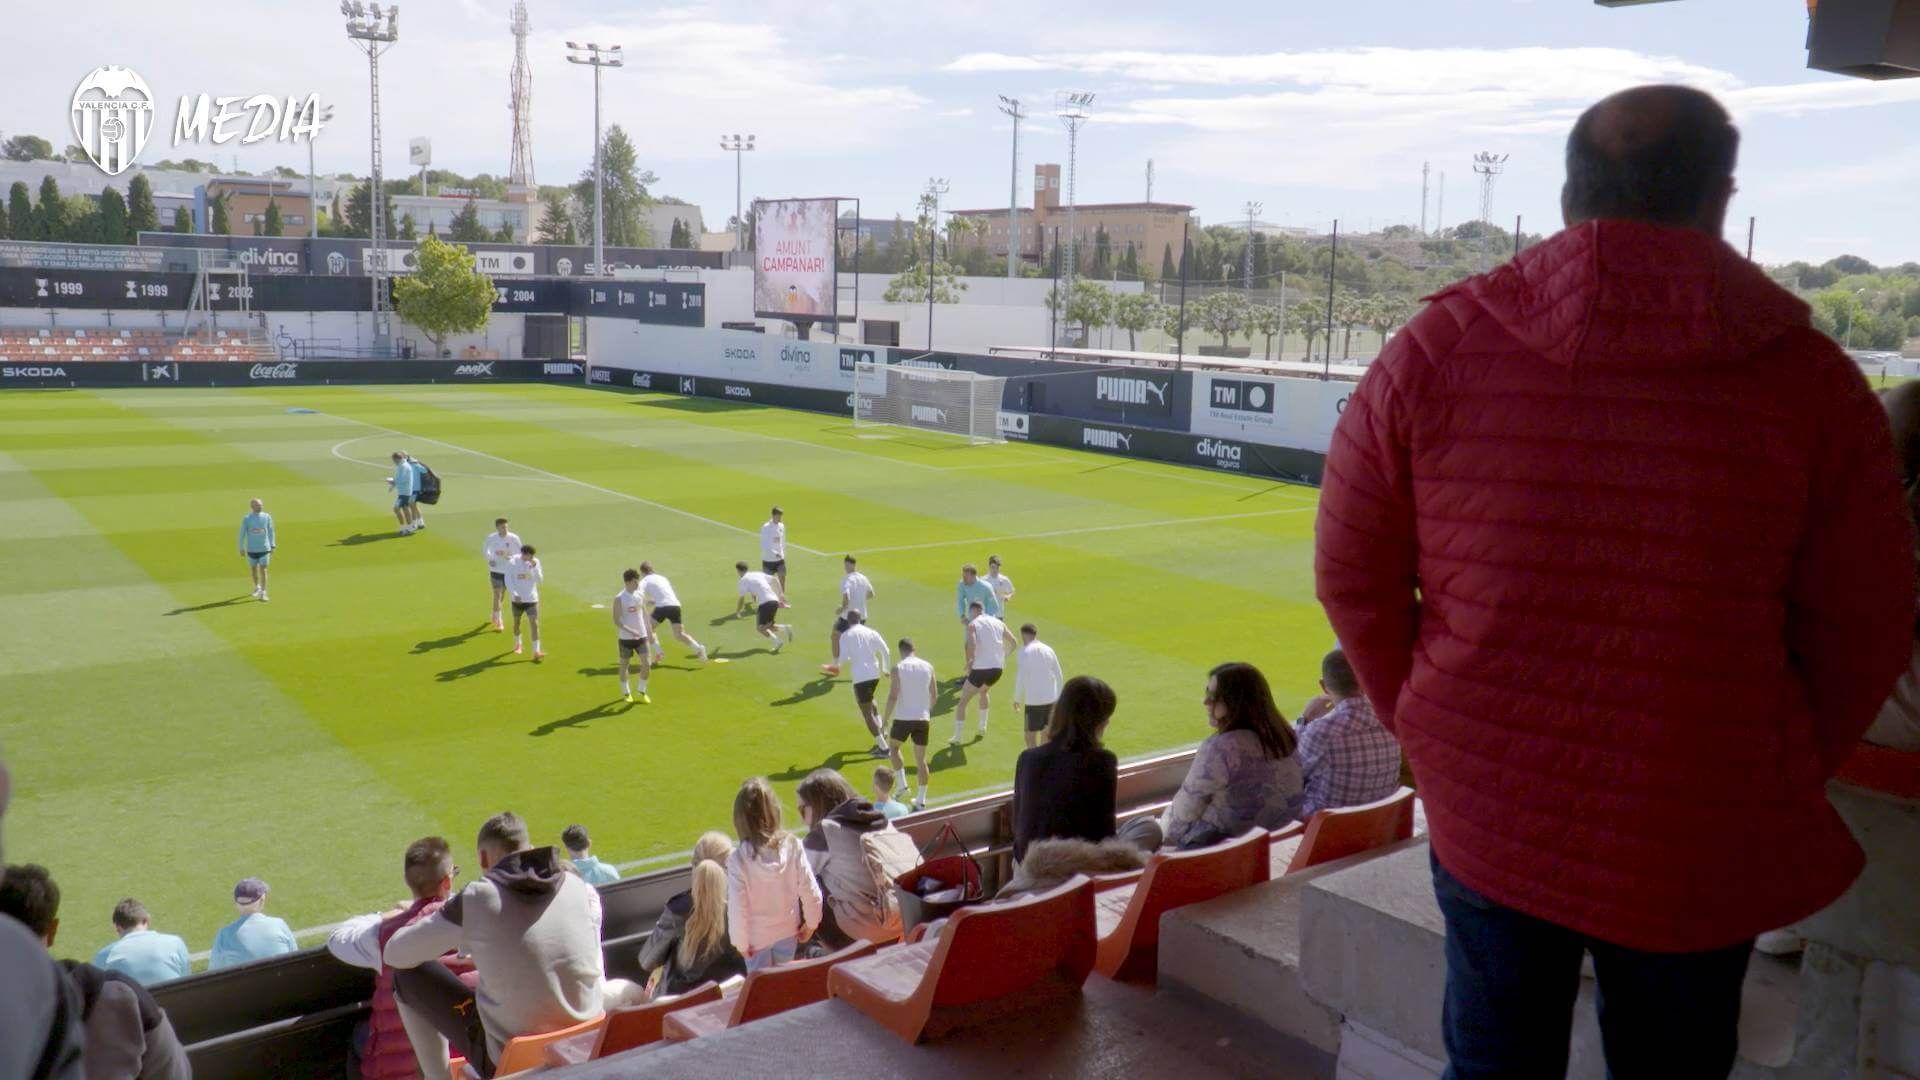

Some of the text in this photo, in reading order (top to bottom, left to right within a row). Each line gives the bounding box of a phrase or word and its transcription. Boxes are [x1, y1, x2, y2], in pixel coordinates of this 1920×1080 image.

[776, 240, 811, 255] AMUNT
[240, 248, 298, 265] divina
[480, 257, 500, 269] TM
[53, 282, 83, 296] 1999
[141, 284, 168, 297] 1999
[513, 290, 535, 302] 2004
[725, 348, 756, 360] SKODA
[3, 367, 66, 377] SKODA
[544, 362, 574, 374] PUMA
[725, 384, 751, 397] SKODA
[1097, 375, 1147, 404] PUMA
[1214, 385, 1236, 405] TM
[1083, 427, 1119, 449] PUMA
[1197, 438, 1242, 460] divina
